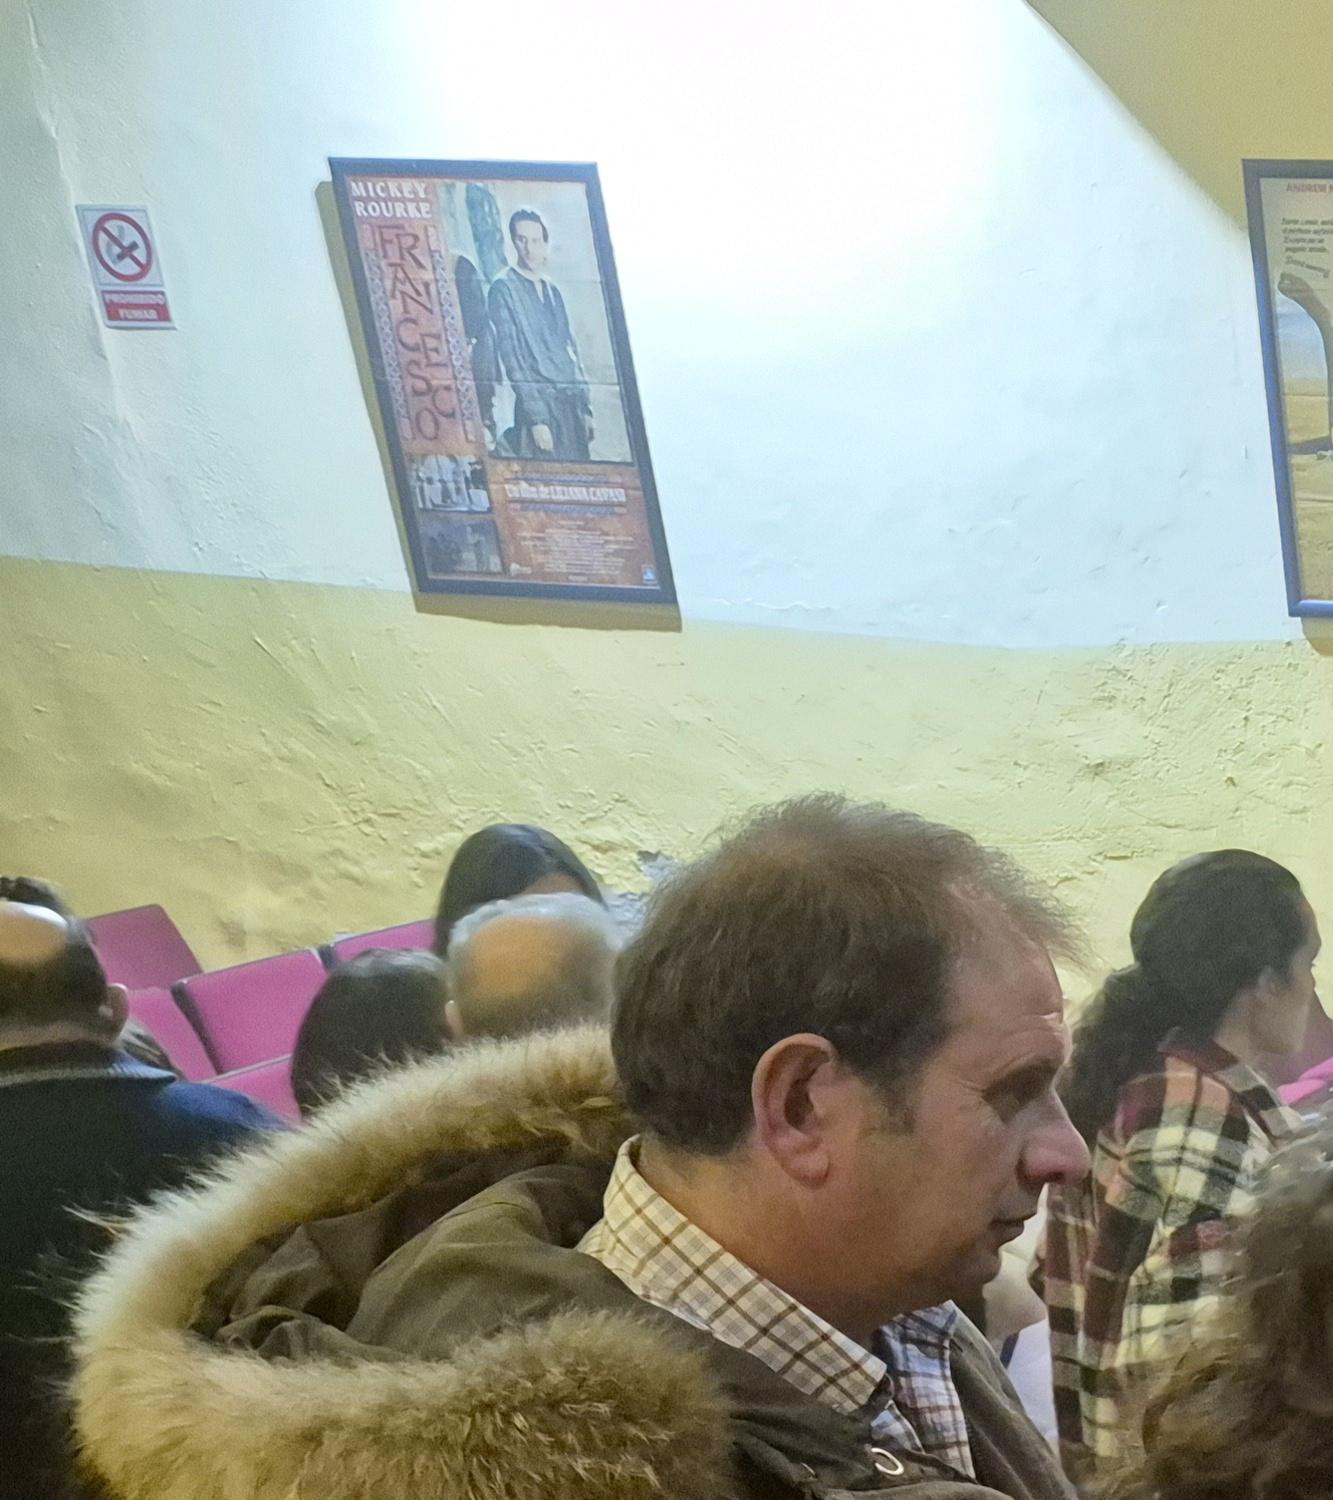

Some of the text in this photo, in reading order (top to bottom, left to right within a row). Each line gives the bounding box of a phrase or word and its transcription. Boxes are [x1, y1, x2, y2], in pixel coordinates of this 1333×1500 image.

[350, 180, 427, 199] MICKEY
[1286, 182, 1327, 194] ANDREW
[354, 201, 432, 219] ROURKE
